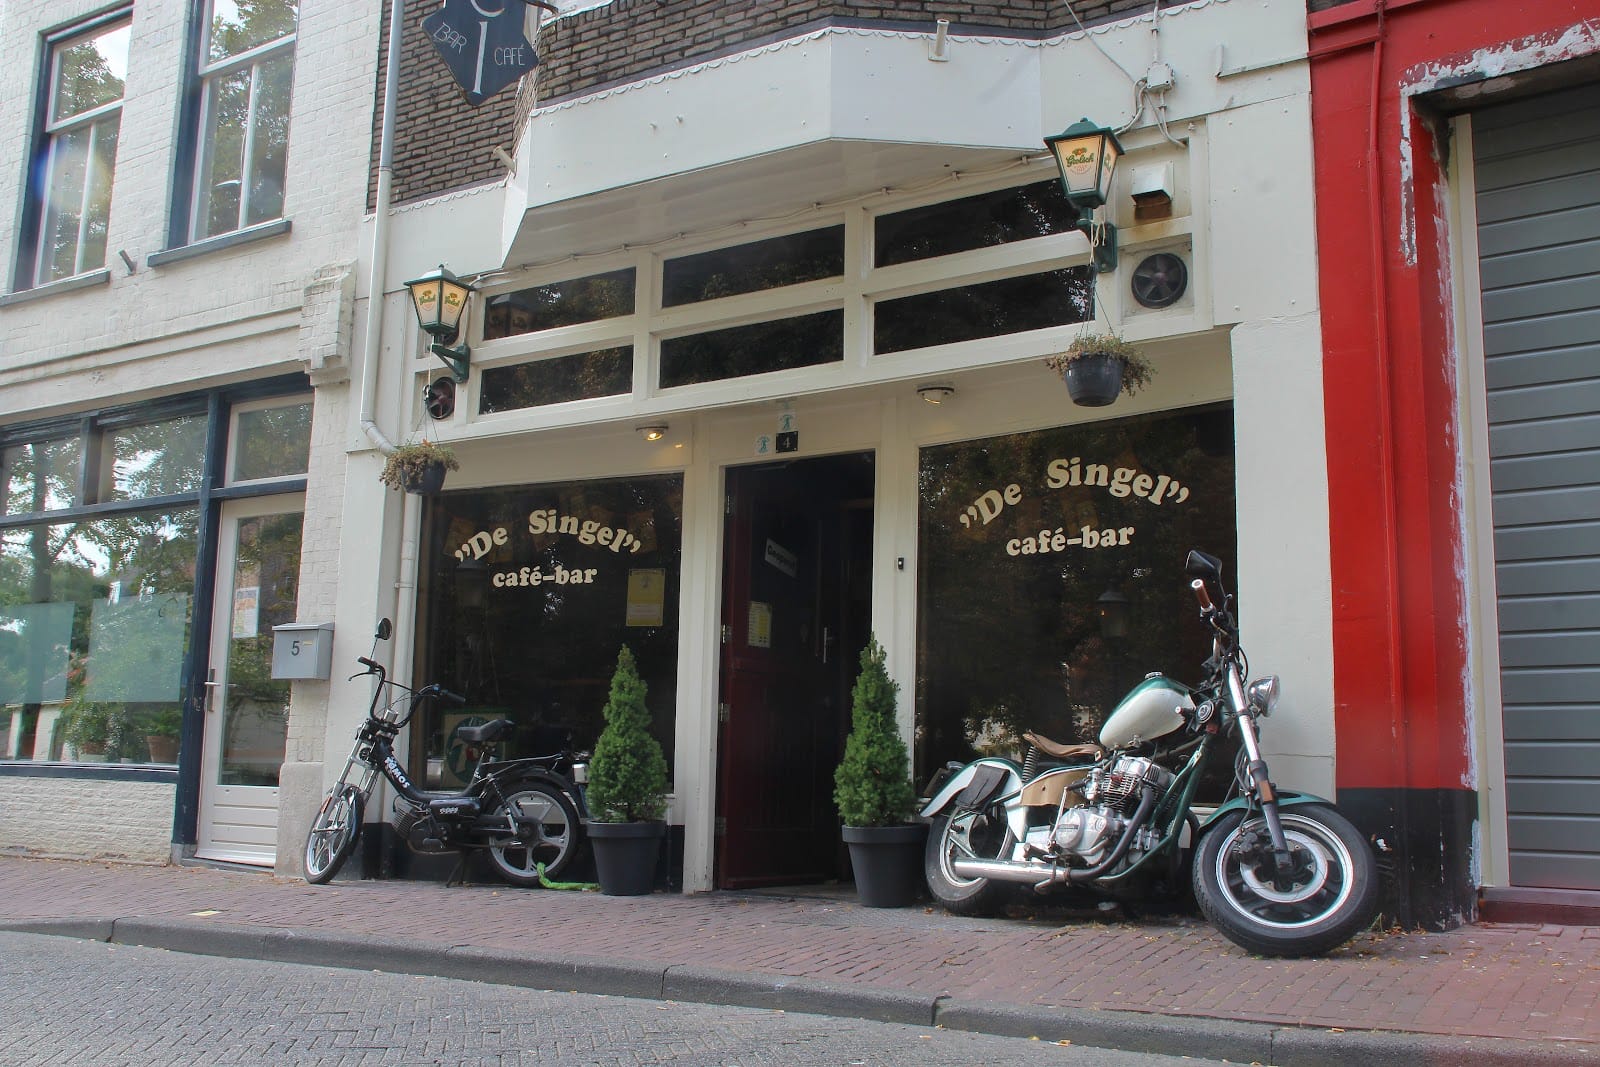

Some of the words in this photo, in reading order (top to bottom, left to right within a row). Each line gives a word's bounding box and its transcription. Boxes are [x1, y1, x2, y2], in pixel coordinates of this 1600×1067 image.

[433, 21, 467, 55] BAR
[493, 43, 526, 66] CAFÉ
[1006, 525, 1135, 556] café-bar
[492, 565, 598, 588] café-bar
[291, 640, 300, 656] 5
